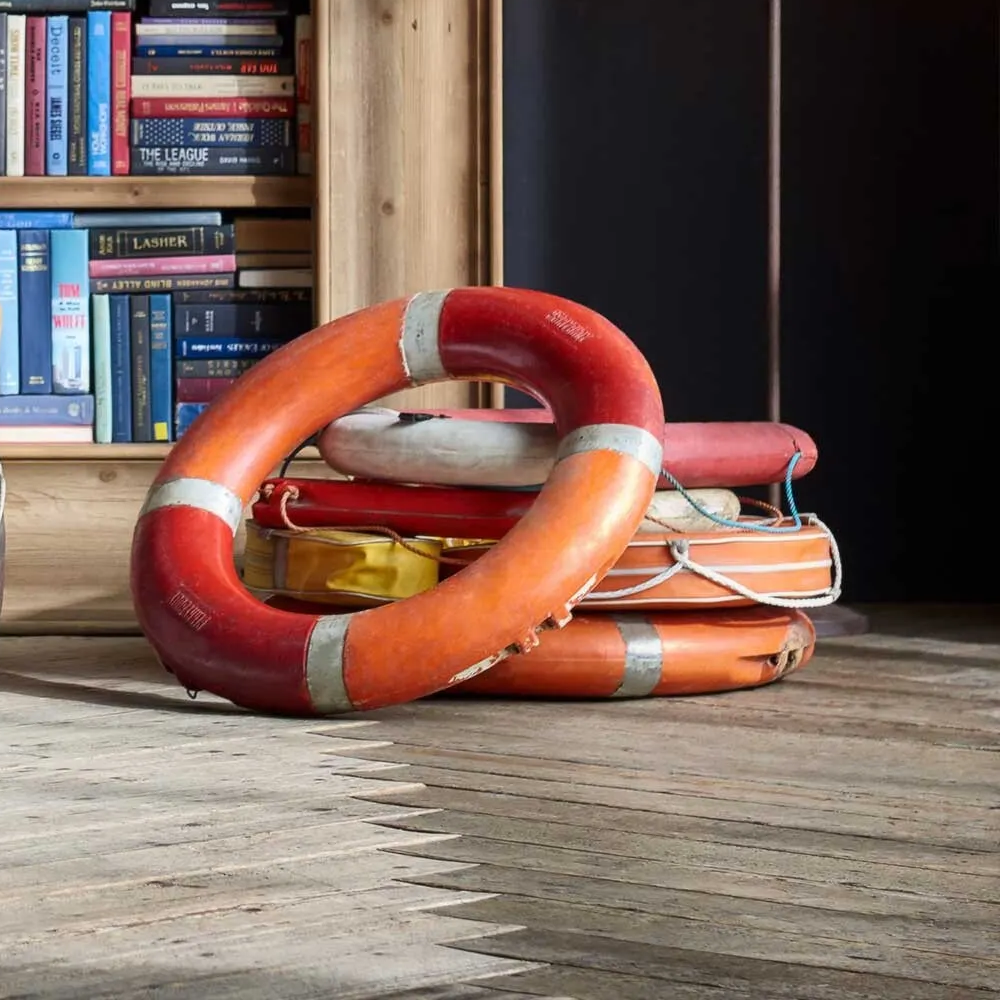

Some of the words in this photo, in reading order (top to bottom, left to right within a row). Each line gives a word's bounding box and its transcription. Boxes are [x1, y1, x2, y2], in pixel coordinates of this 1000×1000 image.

[50, 26, 63, 76] Deceit
[50, 96, 62, 118] JAMES
[164, 101, 205, 113] Patterson
[272, 102, 288, 113] The
[50, 119, 62, 141] SIEGEL
[140, 147, 161, 161] THE
[165, 147, 209, 161] LEAGUE
[133, 235, 188, 250] LASHER
[112, 280, 142, 289] ALLEY
[144, 279, 172, 288] BLIND
